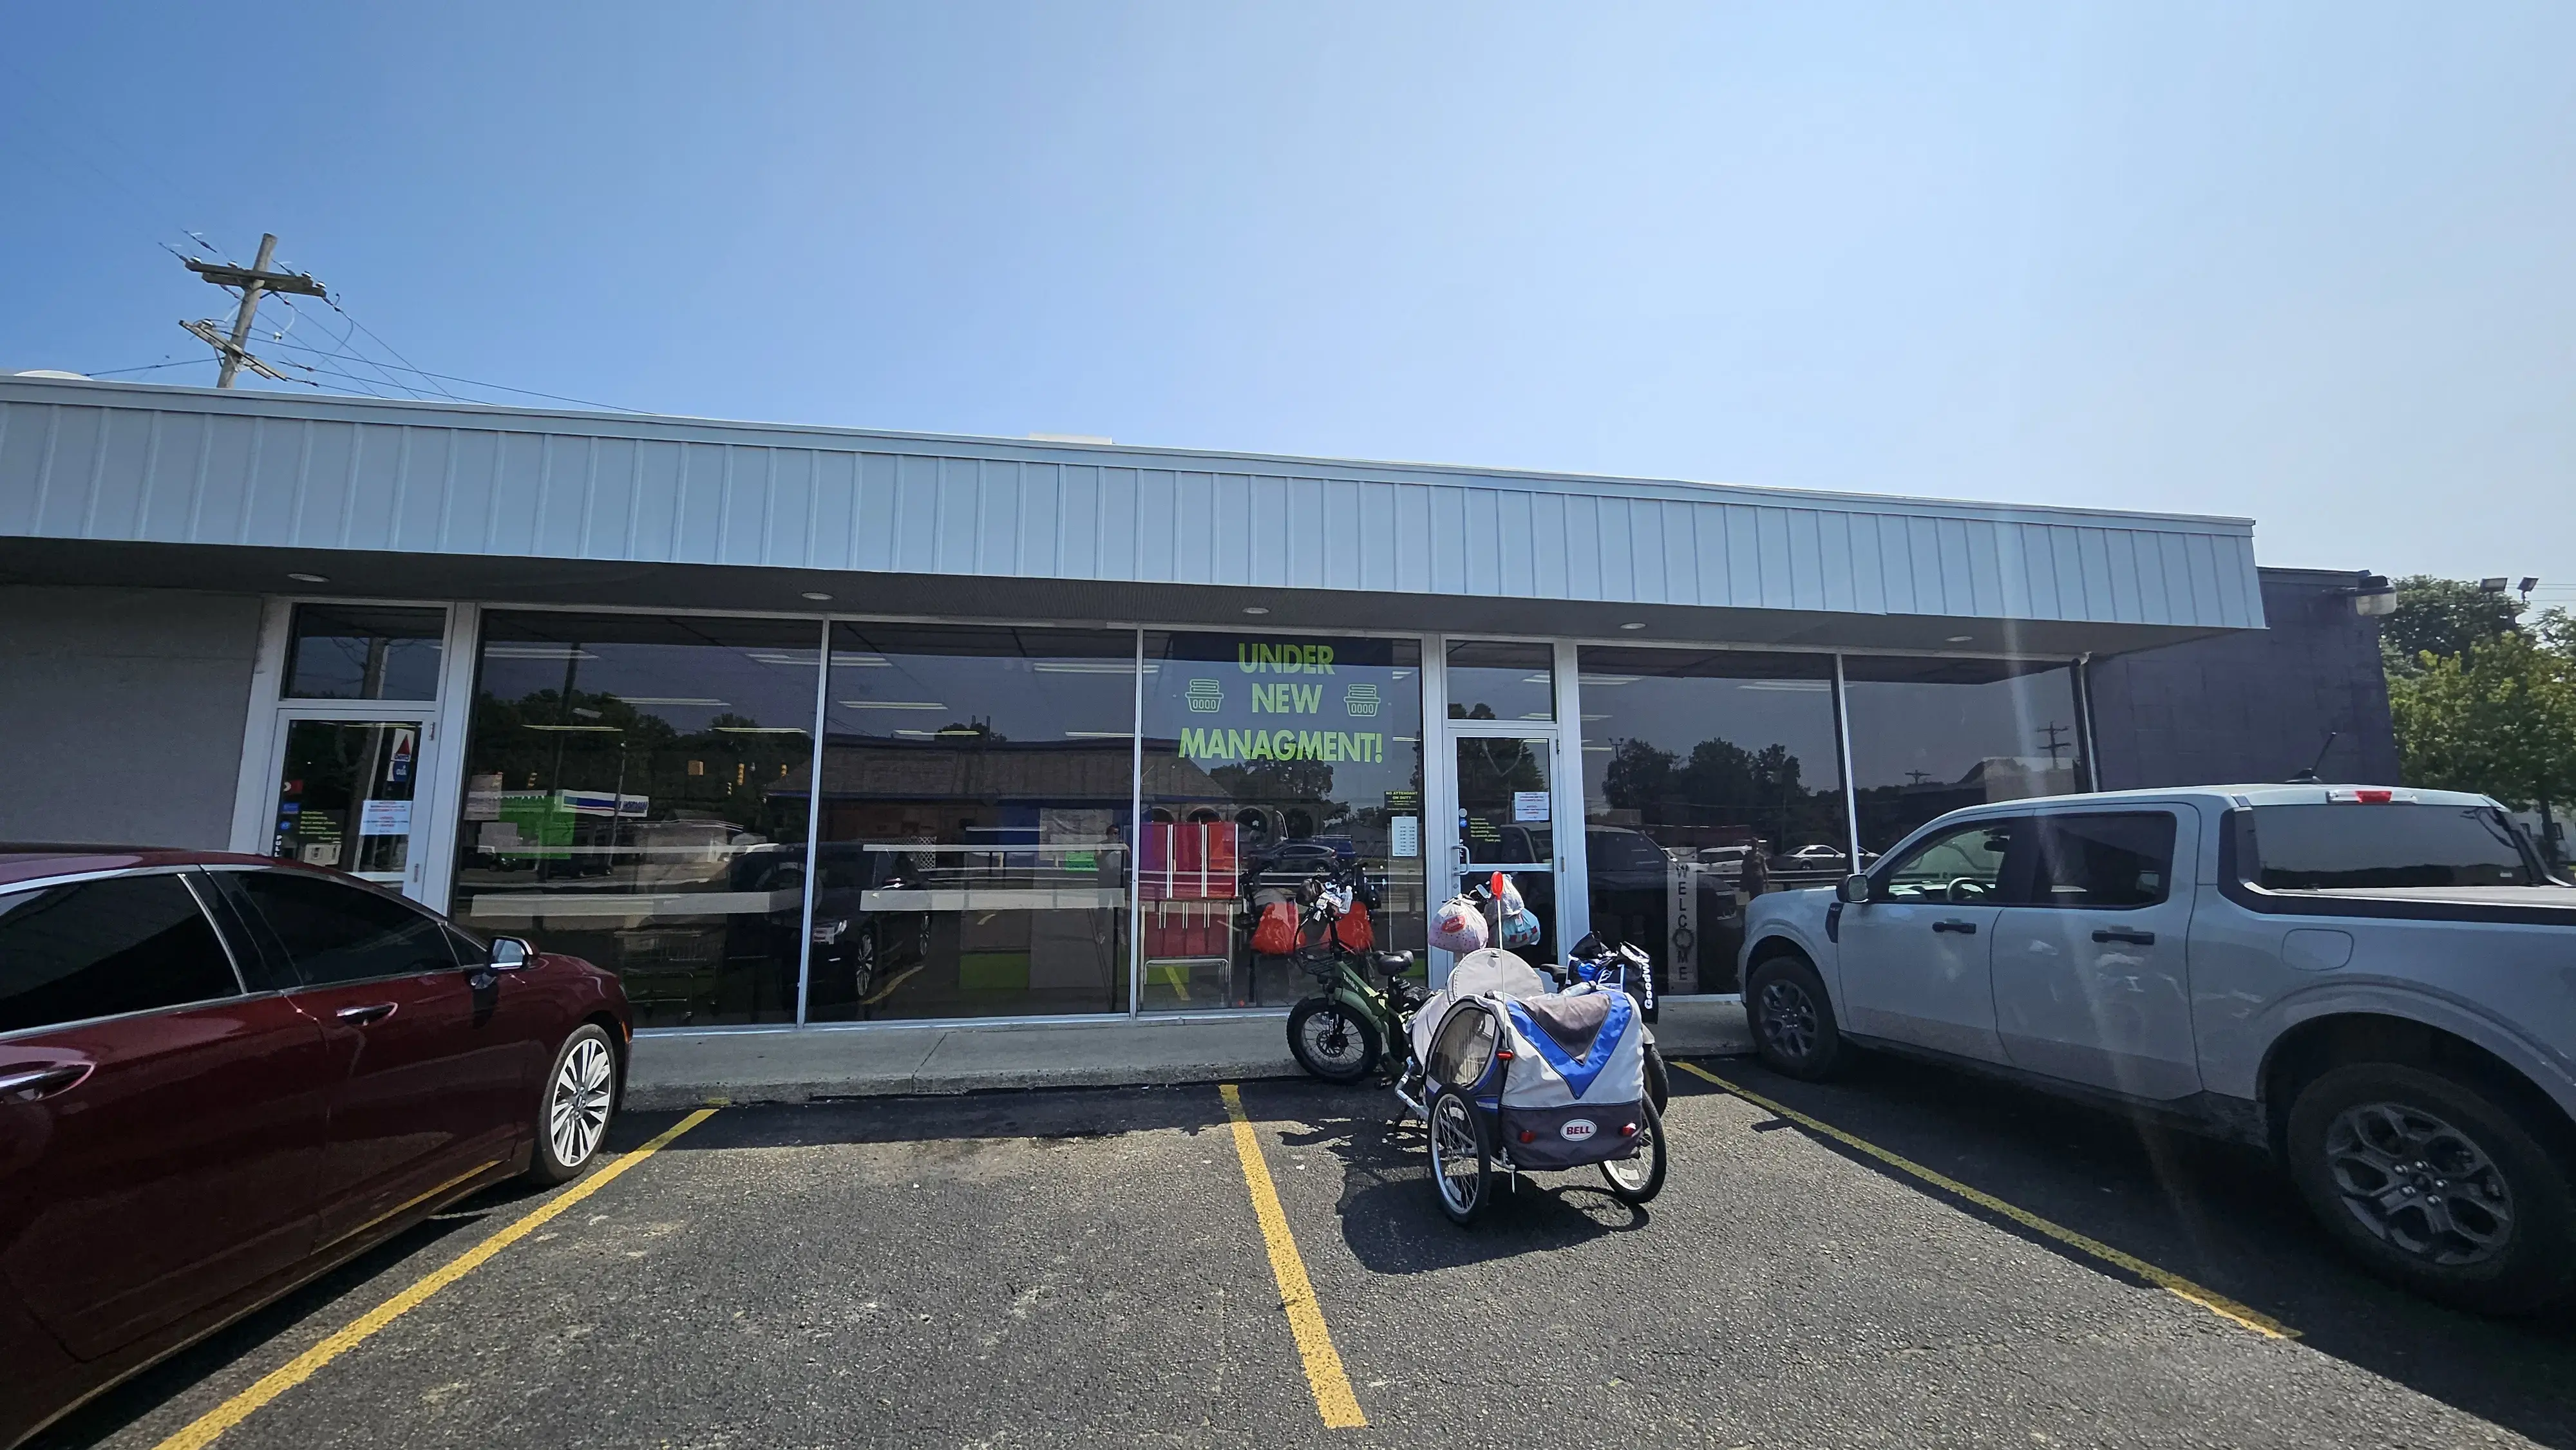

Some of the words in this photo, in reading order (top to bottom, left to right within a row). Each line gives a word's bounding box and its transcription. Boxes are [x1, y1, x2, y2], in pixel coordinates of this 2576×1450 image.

[1238, 643, 1335, 675] UNDER
[1252, 683, 1323, 713] NEW
[1179, 728, 1382, 763] MANAGMENT!
[1673, 865, 1693, 981] WELCOME
[1566, 1126, 1591, 1135] BELL
